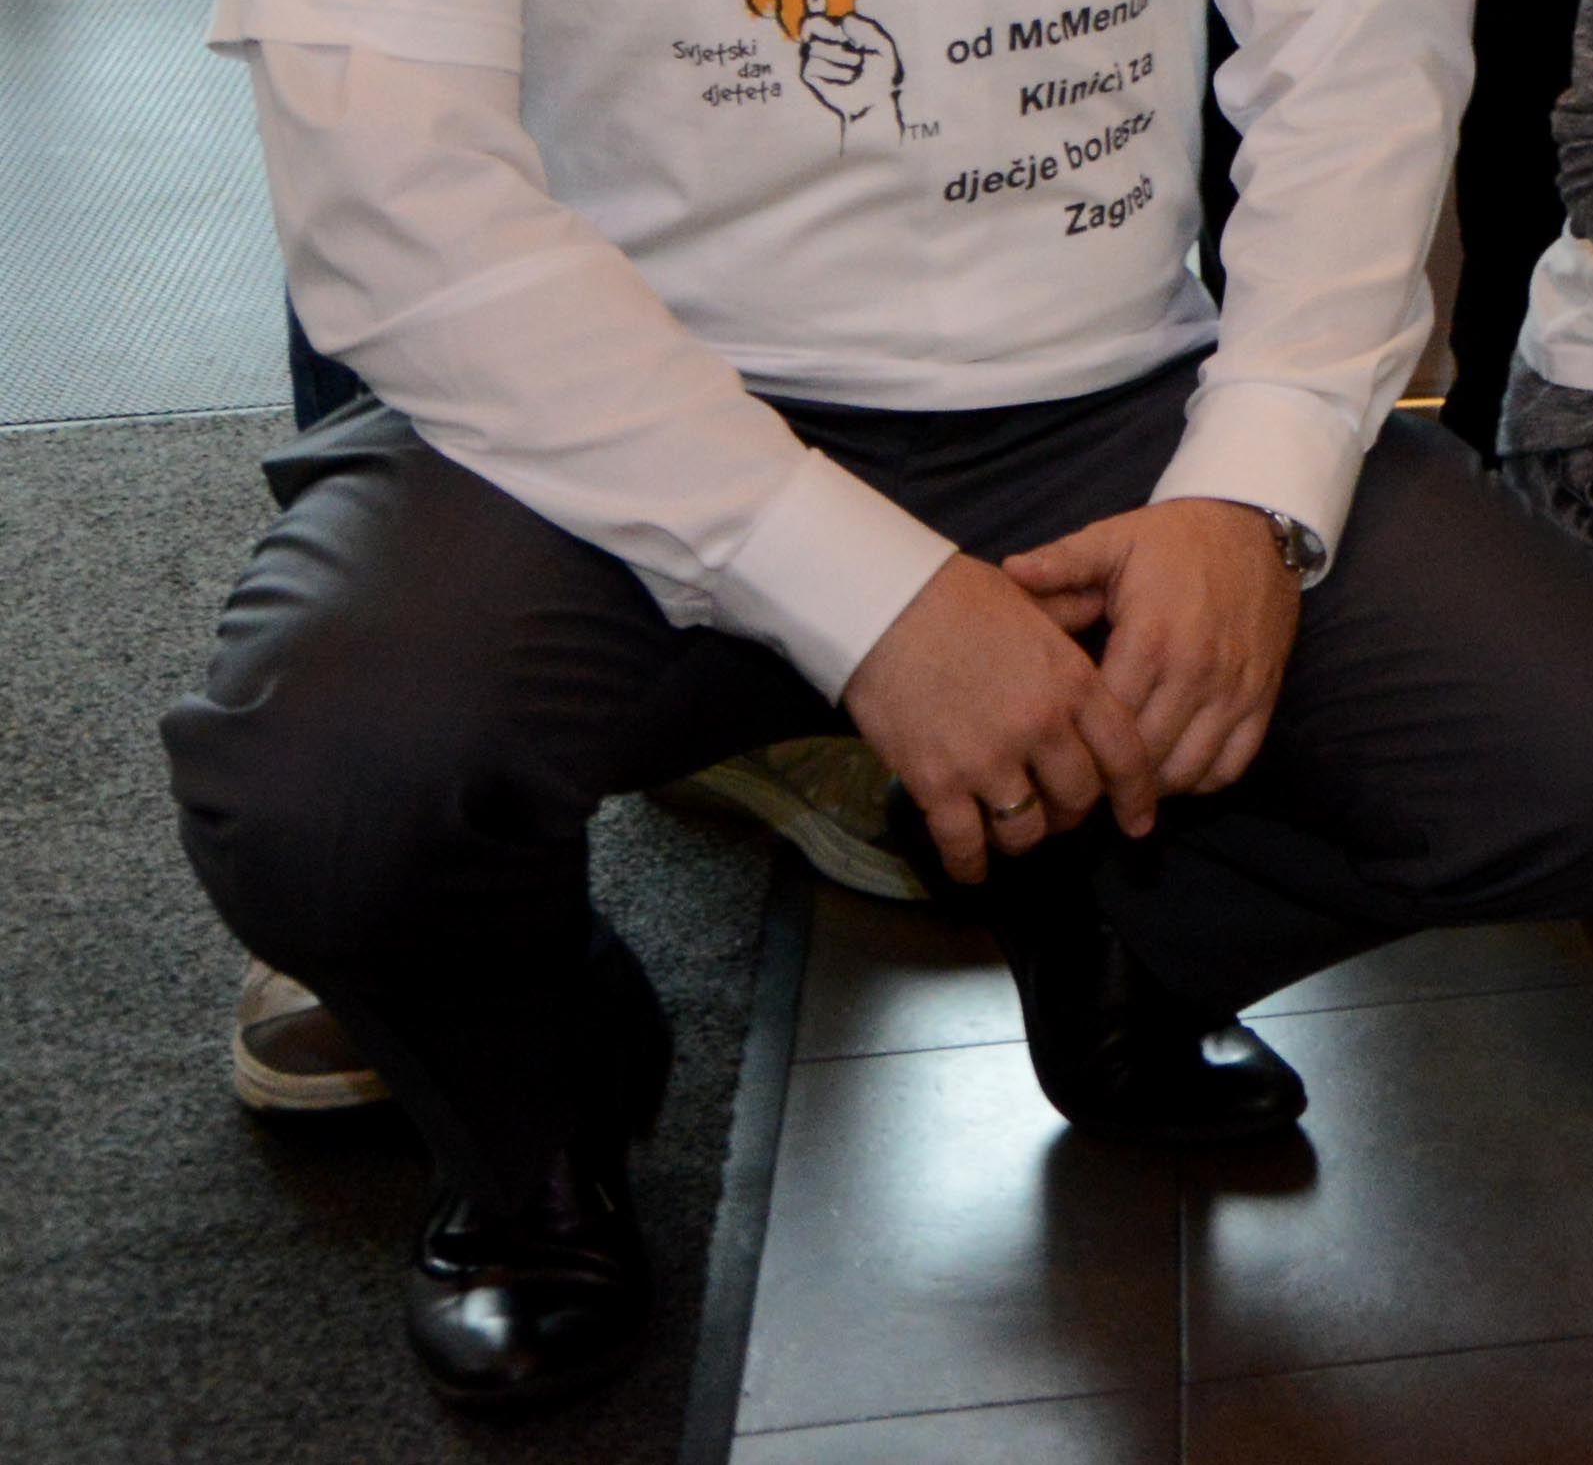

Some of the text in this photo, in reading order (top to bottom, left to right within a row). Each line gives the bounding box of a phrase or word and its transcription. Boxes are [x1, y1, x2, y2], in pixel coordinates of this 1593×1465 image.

[672, 40, 757, 66] Svjetski
[947, 27, 993, 64] od
[1019, 52, 1154, 116] Klinici za
[943, 155, 1058, 203] dječje
[1064, 174, 1154, 236] Zagreb
